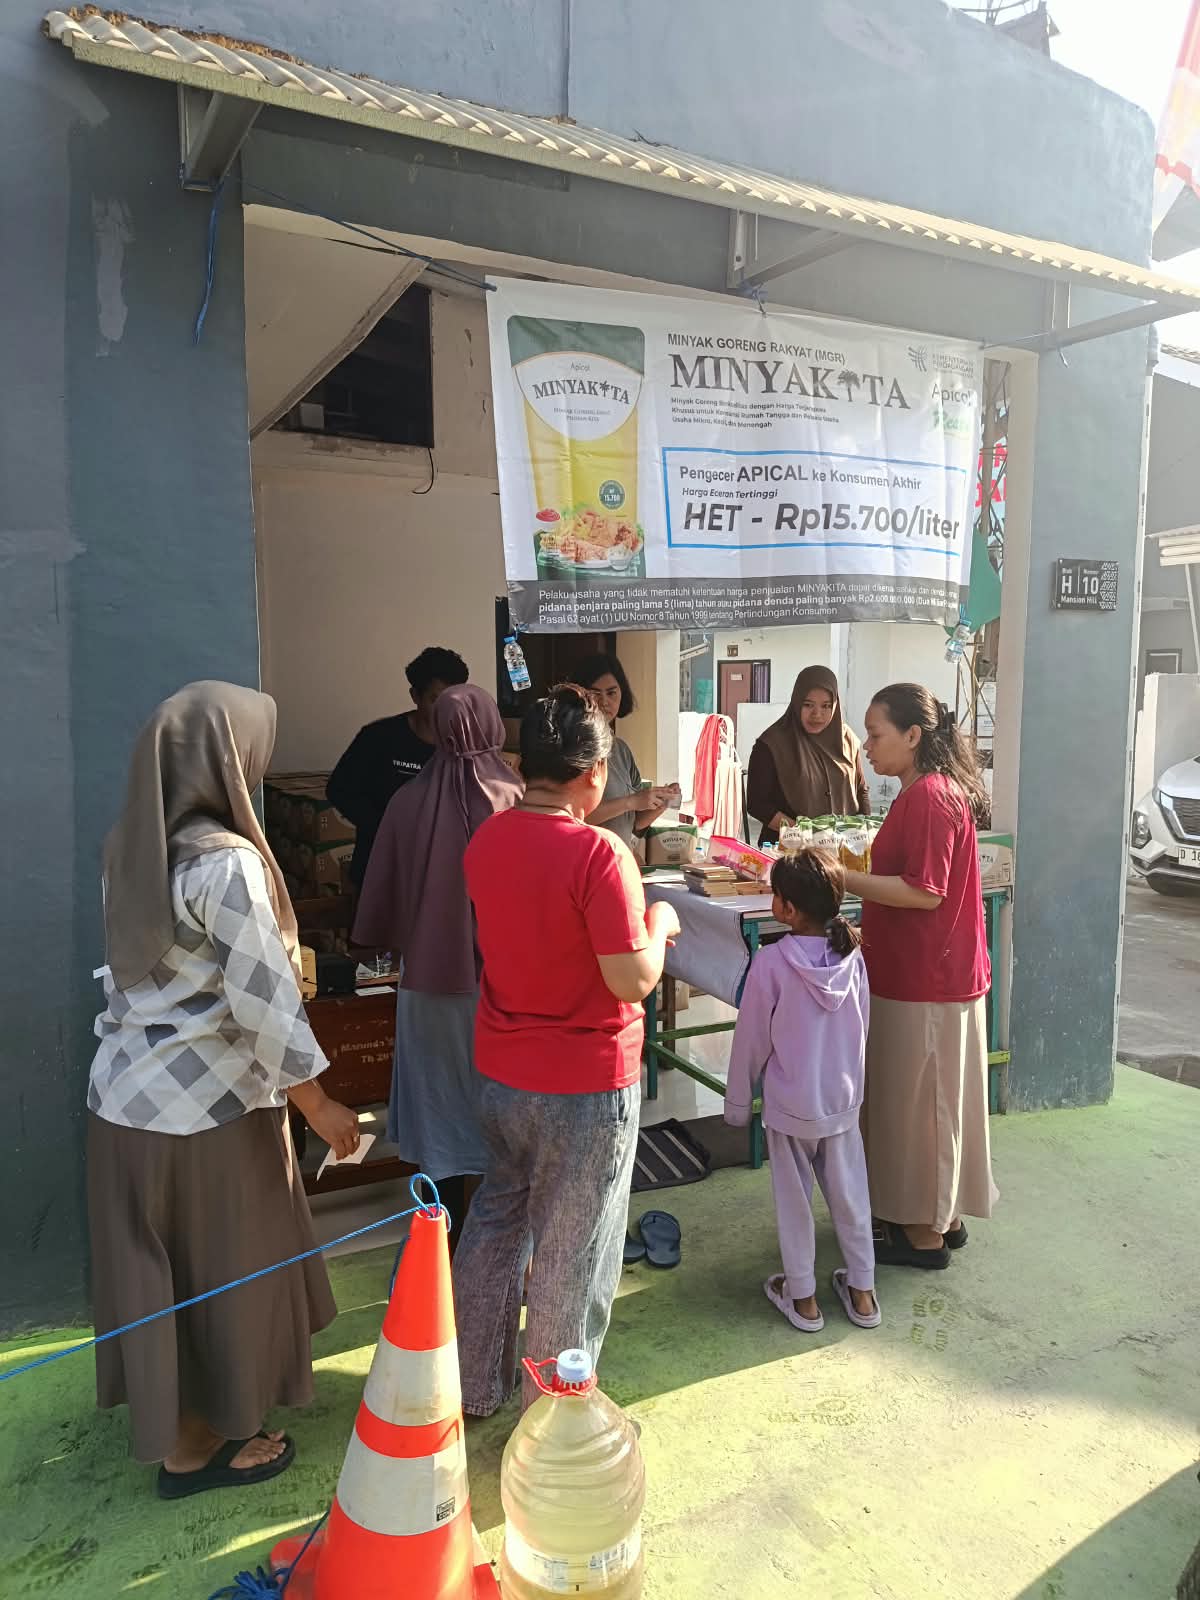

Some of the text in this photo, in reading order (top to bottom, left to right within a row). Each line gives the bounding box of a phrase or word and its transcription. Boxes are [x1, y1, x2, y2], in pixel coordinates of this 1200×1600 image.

[667, 333, 847, 366] MINYAK GORENG RAKYAT (MGR)
[748, 402, 775, 411] dengan
[737, 421, 773, 429] Menengah
[679, 464, 922, 490] Pengecer APICAL ke Konsumen Akhir
[682, 487, 779, 500] Harga Eceran Tertinggi
[683, 502, 743, 532] HET
[774, 502, 960, 540] Rp15.700/liter
[539, 589, 569, 600] Pelaku
[573, 588, 601, 599] usaha
[603, 588, 625, 600] yang
[627, 587, 649, 598] tidak
[649, 586, 691, 598] mematuhi
[726, 587, 749, 598] harga
[750, 585, 795, 598] penjualan
[797, 583, 847, 594] MINYAKITA
[1061, 575, 1099, 595] H 10
[538, 602, 573, 614] pidana
[574, 600, 610, 613] penjara
[611, 599, 641, 612] paling
[641, 599, 663, 610] lama
[664, 599, 669, 609] 5
[670, 598, 695, 611] (lima)
[695, 598, 717, 608] tahun
[732, 598, 762, 609] pidana
[763, 596, 794, 607] denda
[795, 595, 824, 607] paling
[824, 593, 858, 605] banyak
[539, 614, 567, 625] Pasal
[567, 613, 579, 625] 62
[579, 612, 600, 625] ayat
[600, 612, 614, 625] (1)
[614, 611, 630, 622] UU
[630, 611, 658, 622] Nomor
[658, 611, 665, 621] 8
[665, 610, 690, 621] Tahun
[691, 609, 709, 620] 1999
[734, 607, 792, 619] Perlindungan
[792, 606, 839, 617] Konsumen
[392, 759, 422, 770] TRIPATRA
